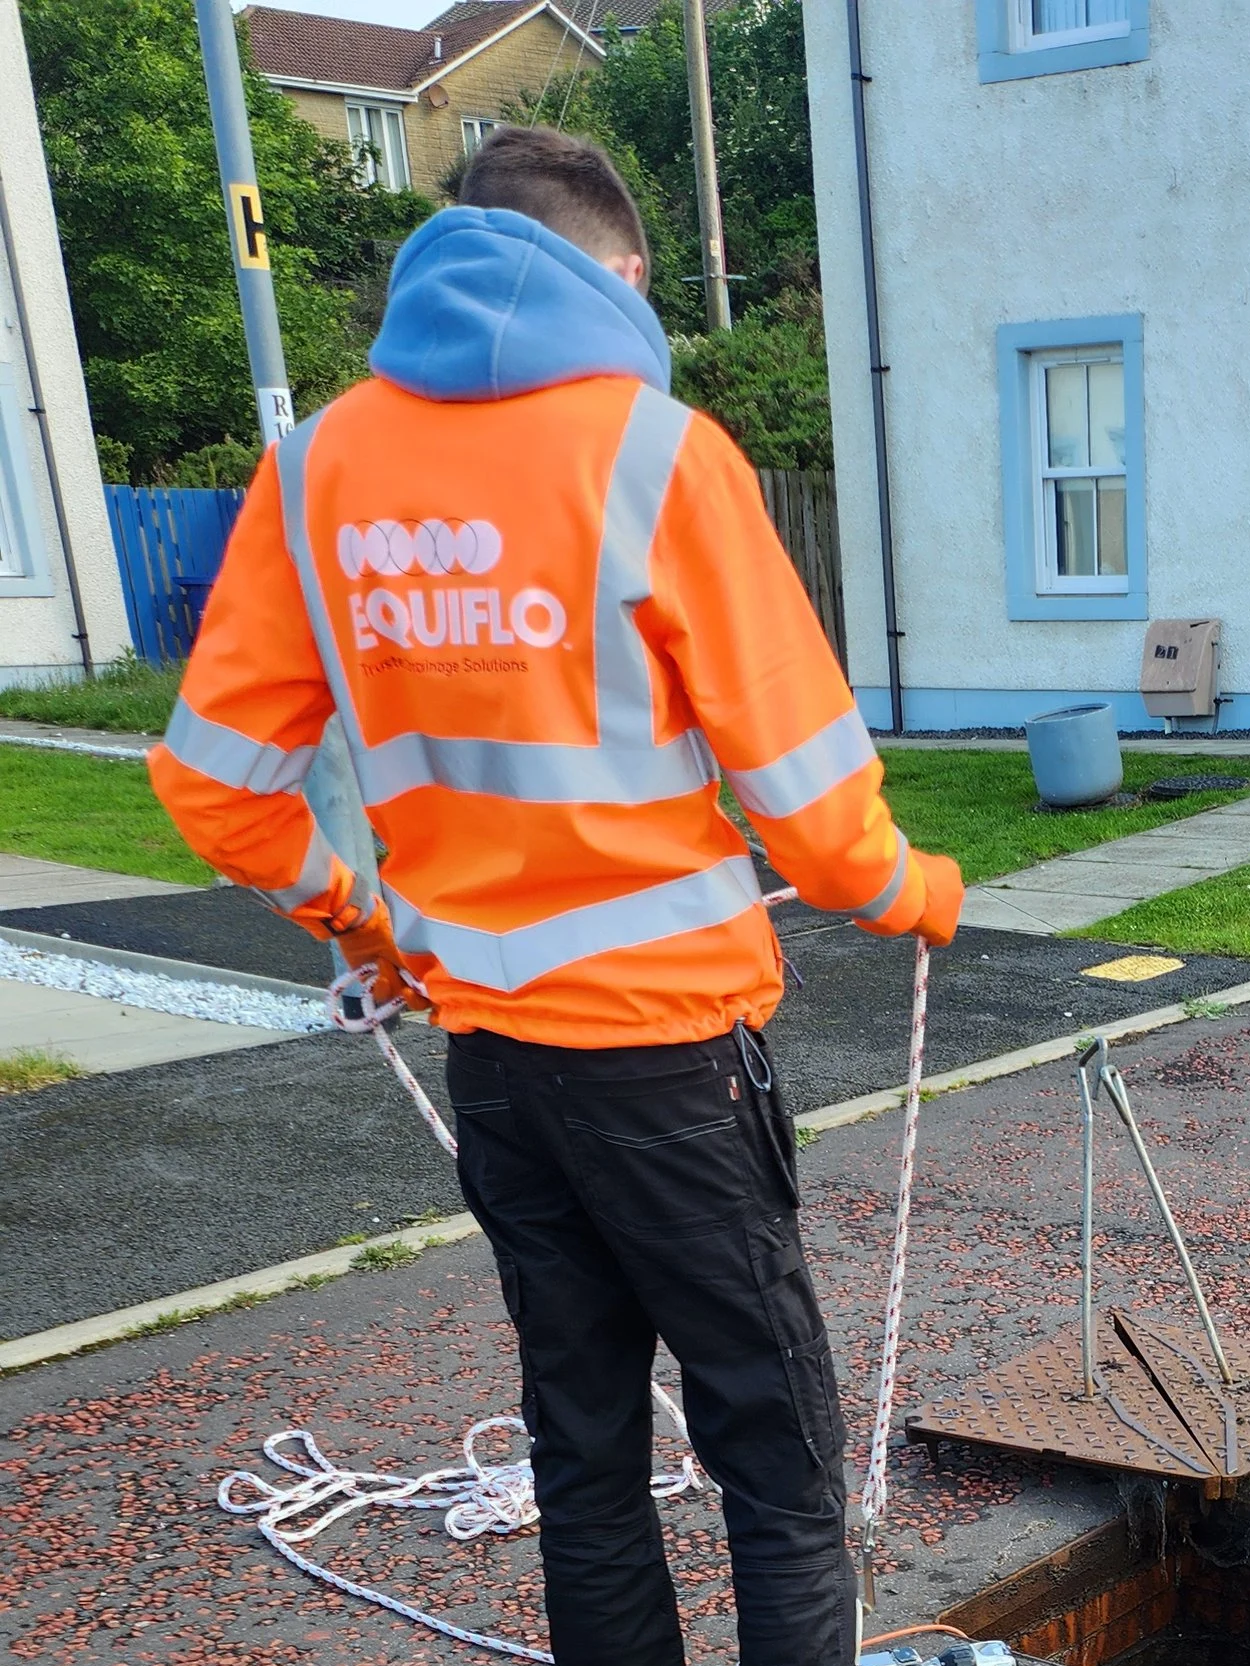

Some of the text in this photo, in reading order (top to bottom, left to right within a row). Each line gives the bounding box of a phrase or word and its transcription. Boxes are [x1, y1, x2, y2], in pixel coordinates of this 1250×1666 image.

[271, 394, 290, 418] R
[347, 587, 567, 651] EQUIFLO
[463, 658, 529, 674] Solutions
